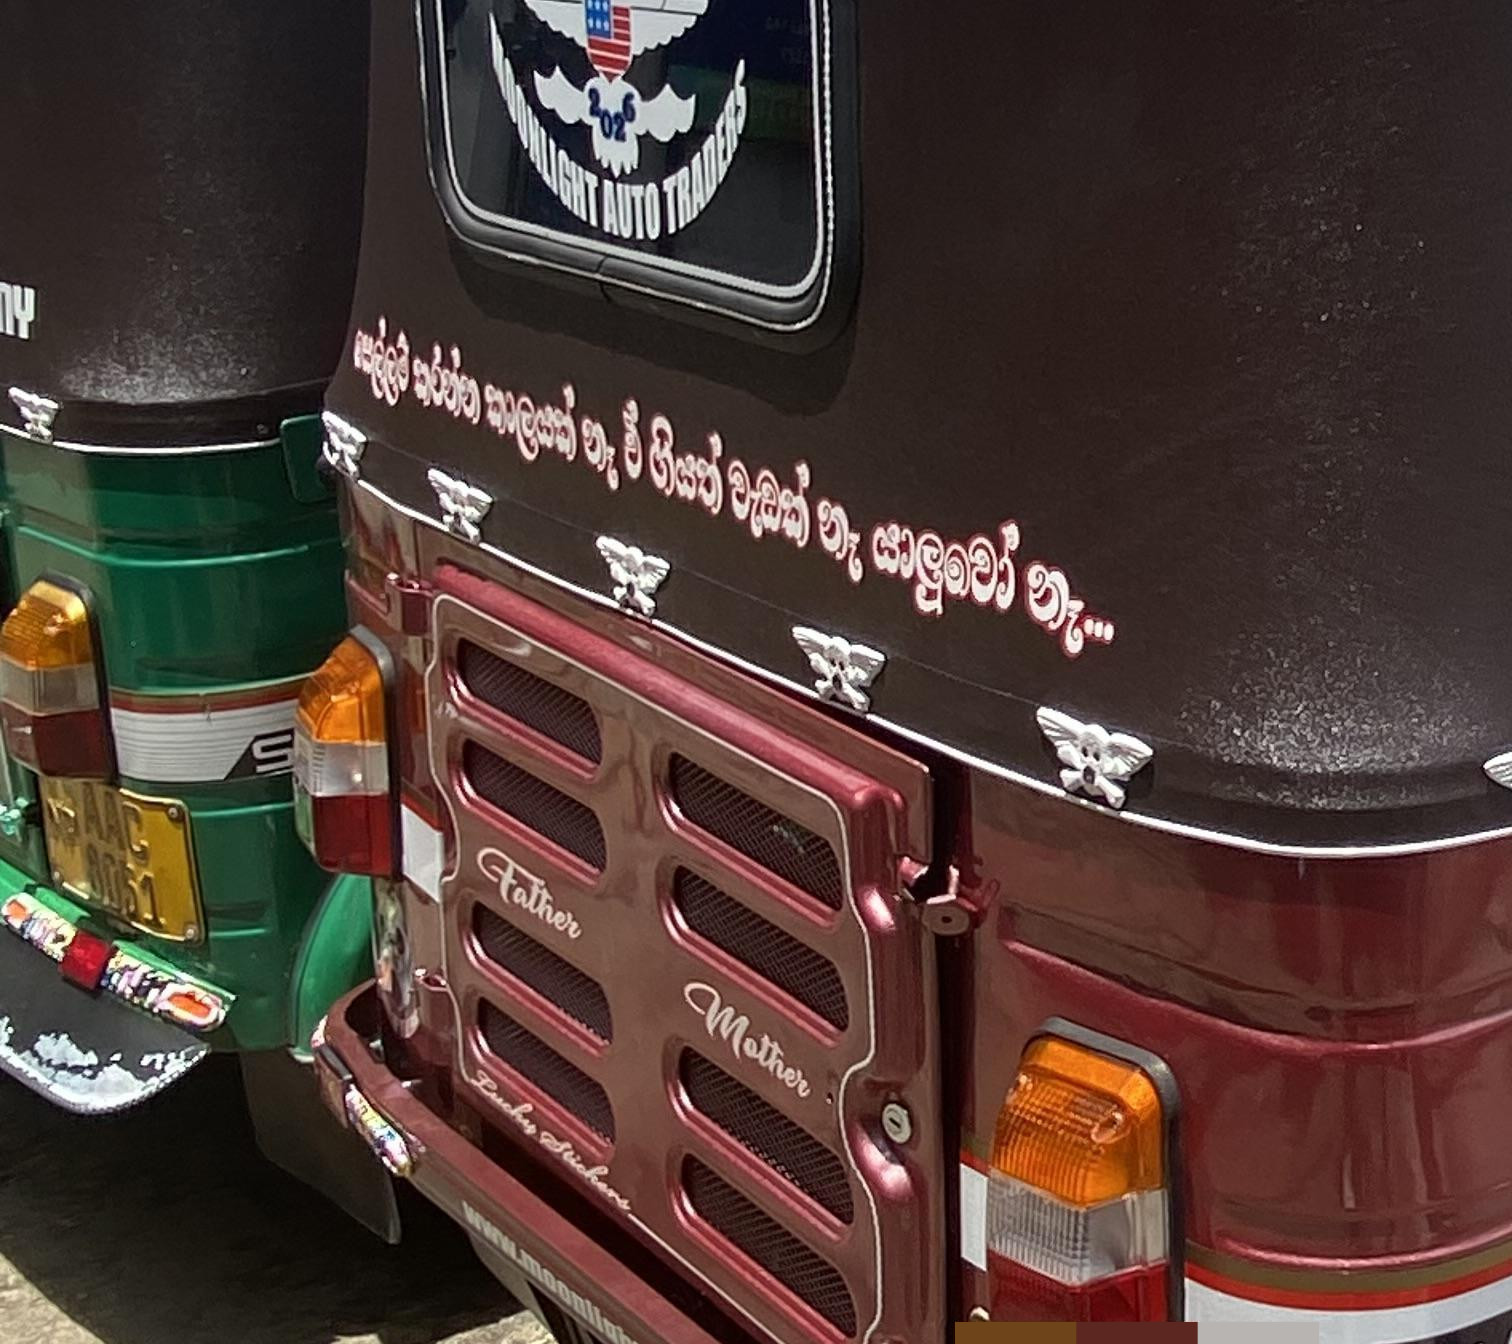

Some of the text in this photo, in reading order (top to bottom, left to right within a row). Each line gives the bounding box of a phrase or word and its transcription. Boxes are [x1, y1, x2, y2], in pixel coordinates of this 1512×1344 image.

[603, 178, 661, 241] AUTO
[662, 58, 748, 235] TRADERS
[477, 847, 583, 940] Father
[683, 982, 812, 1098] Mother
